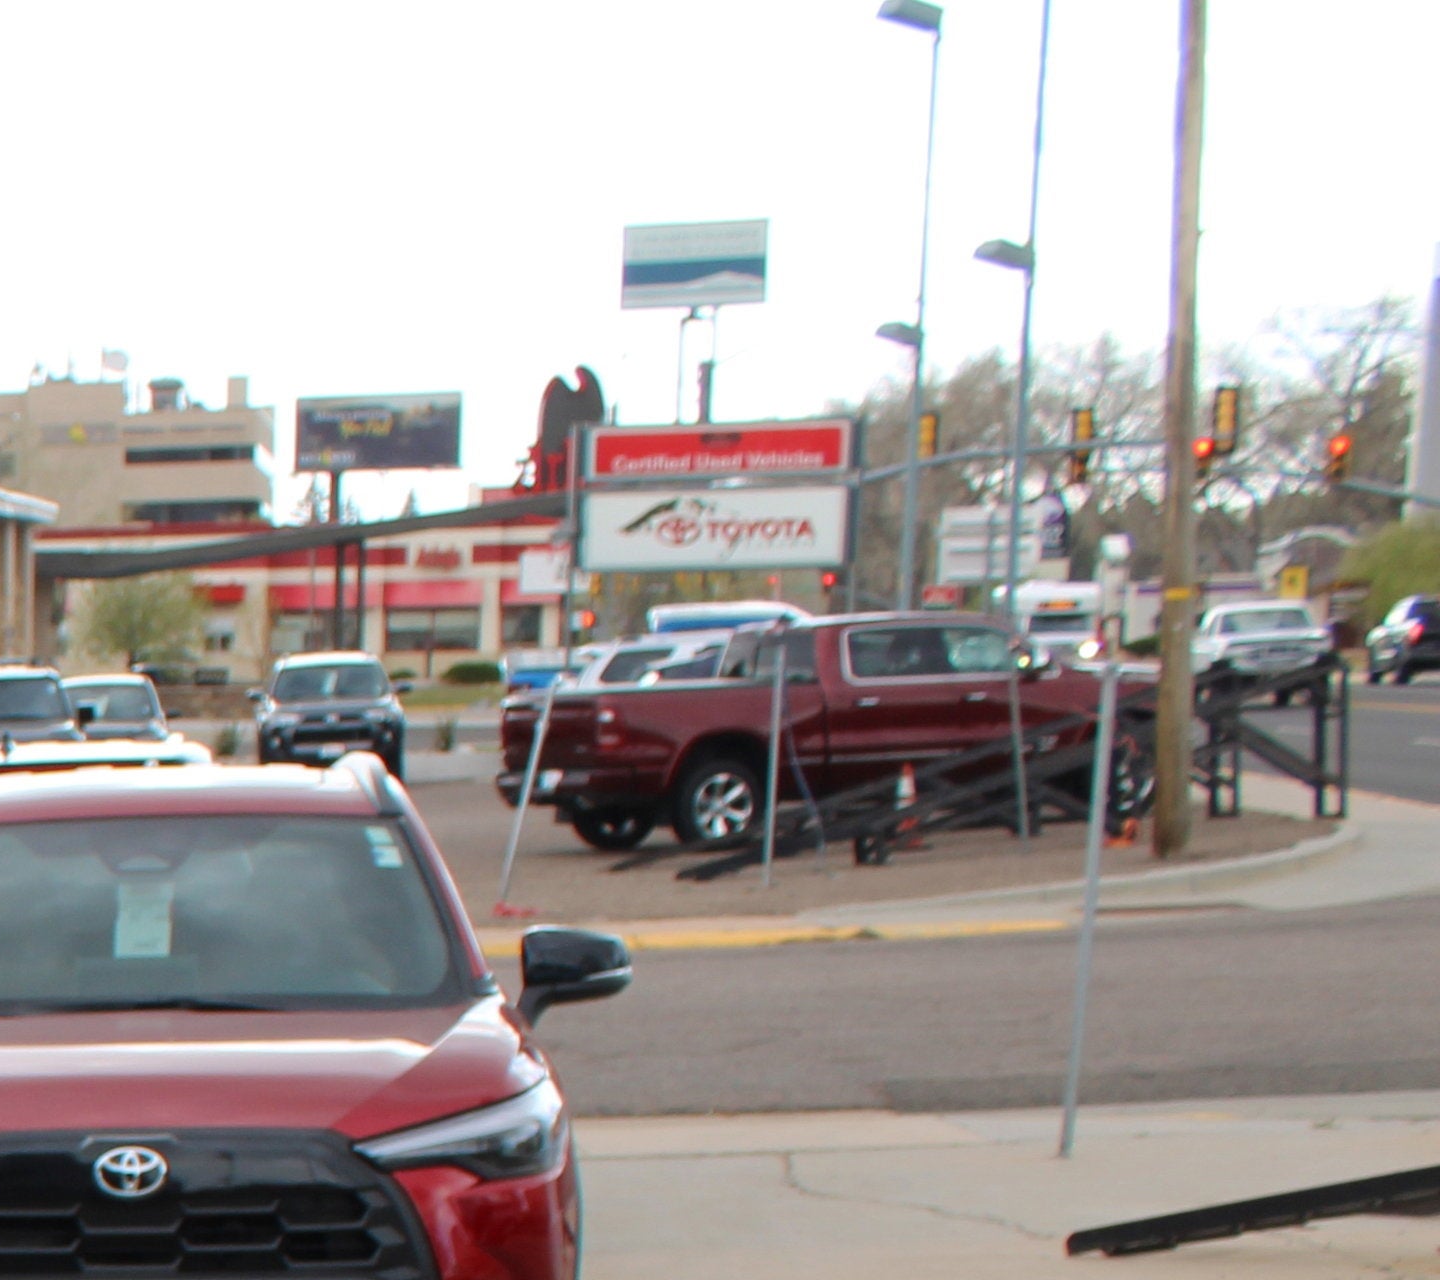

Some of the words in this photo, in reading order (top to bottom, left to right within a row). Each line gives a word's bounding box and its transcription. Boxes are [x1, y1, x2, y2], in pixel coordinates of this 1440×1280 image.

[610, 453, 691, 474] Certified
[694, 450, 743, 470] Used
[748, 449, 825, 469] Vehicles
[706, 518, 815, 540] TOYOTA
